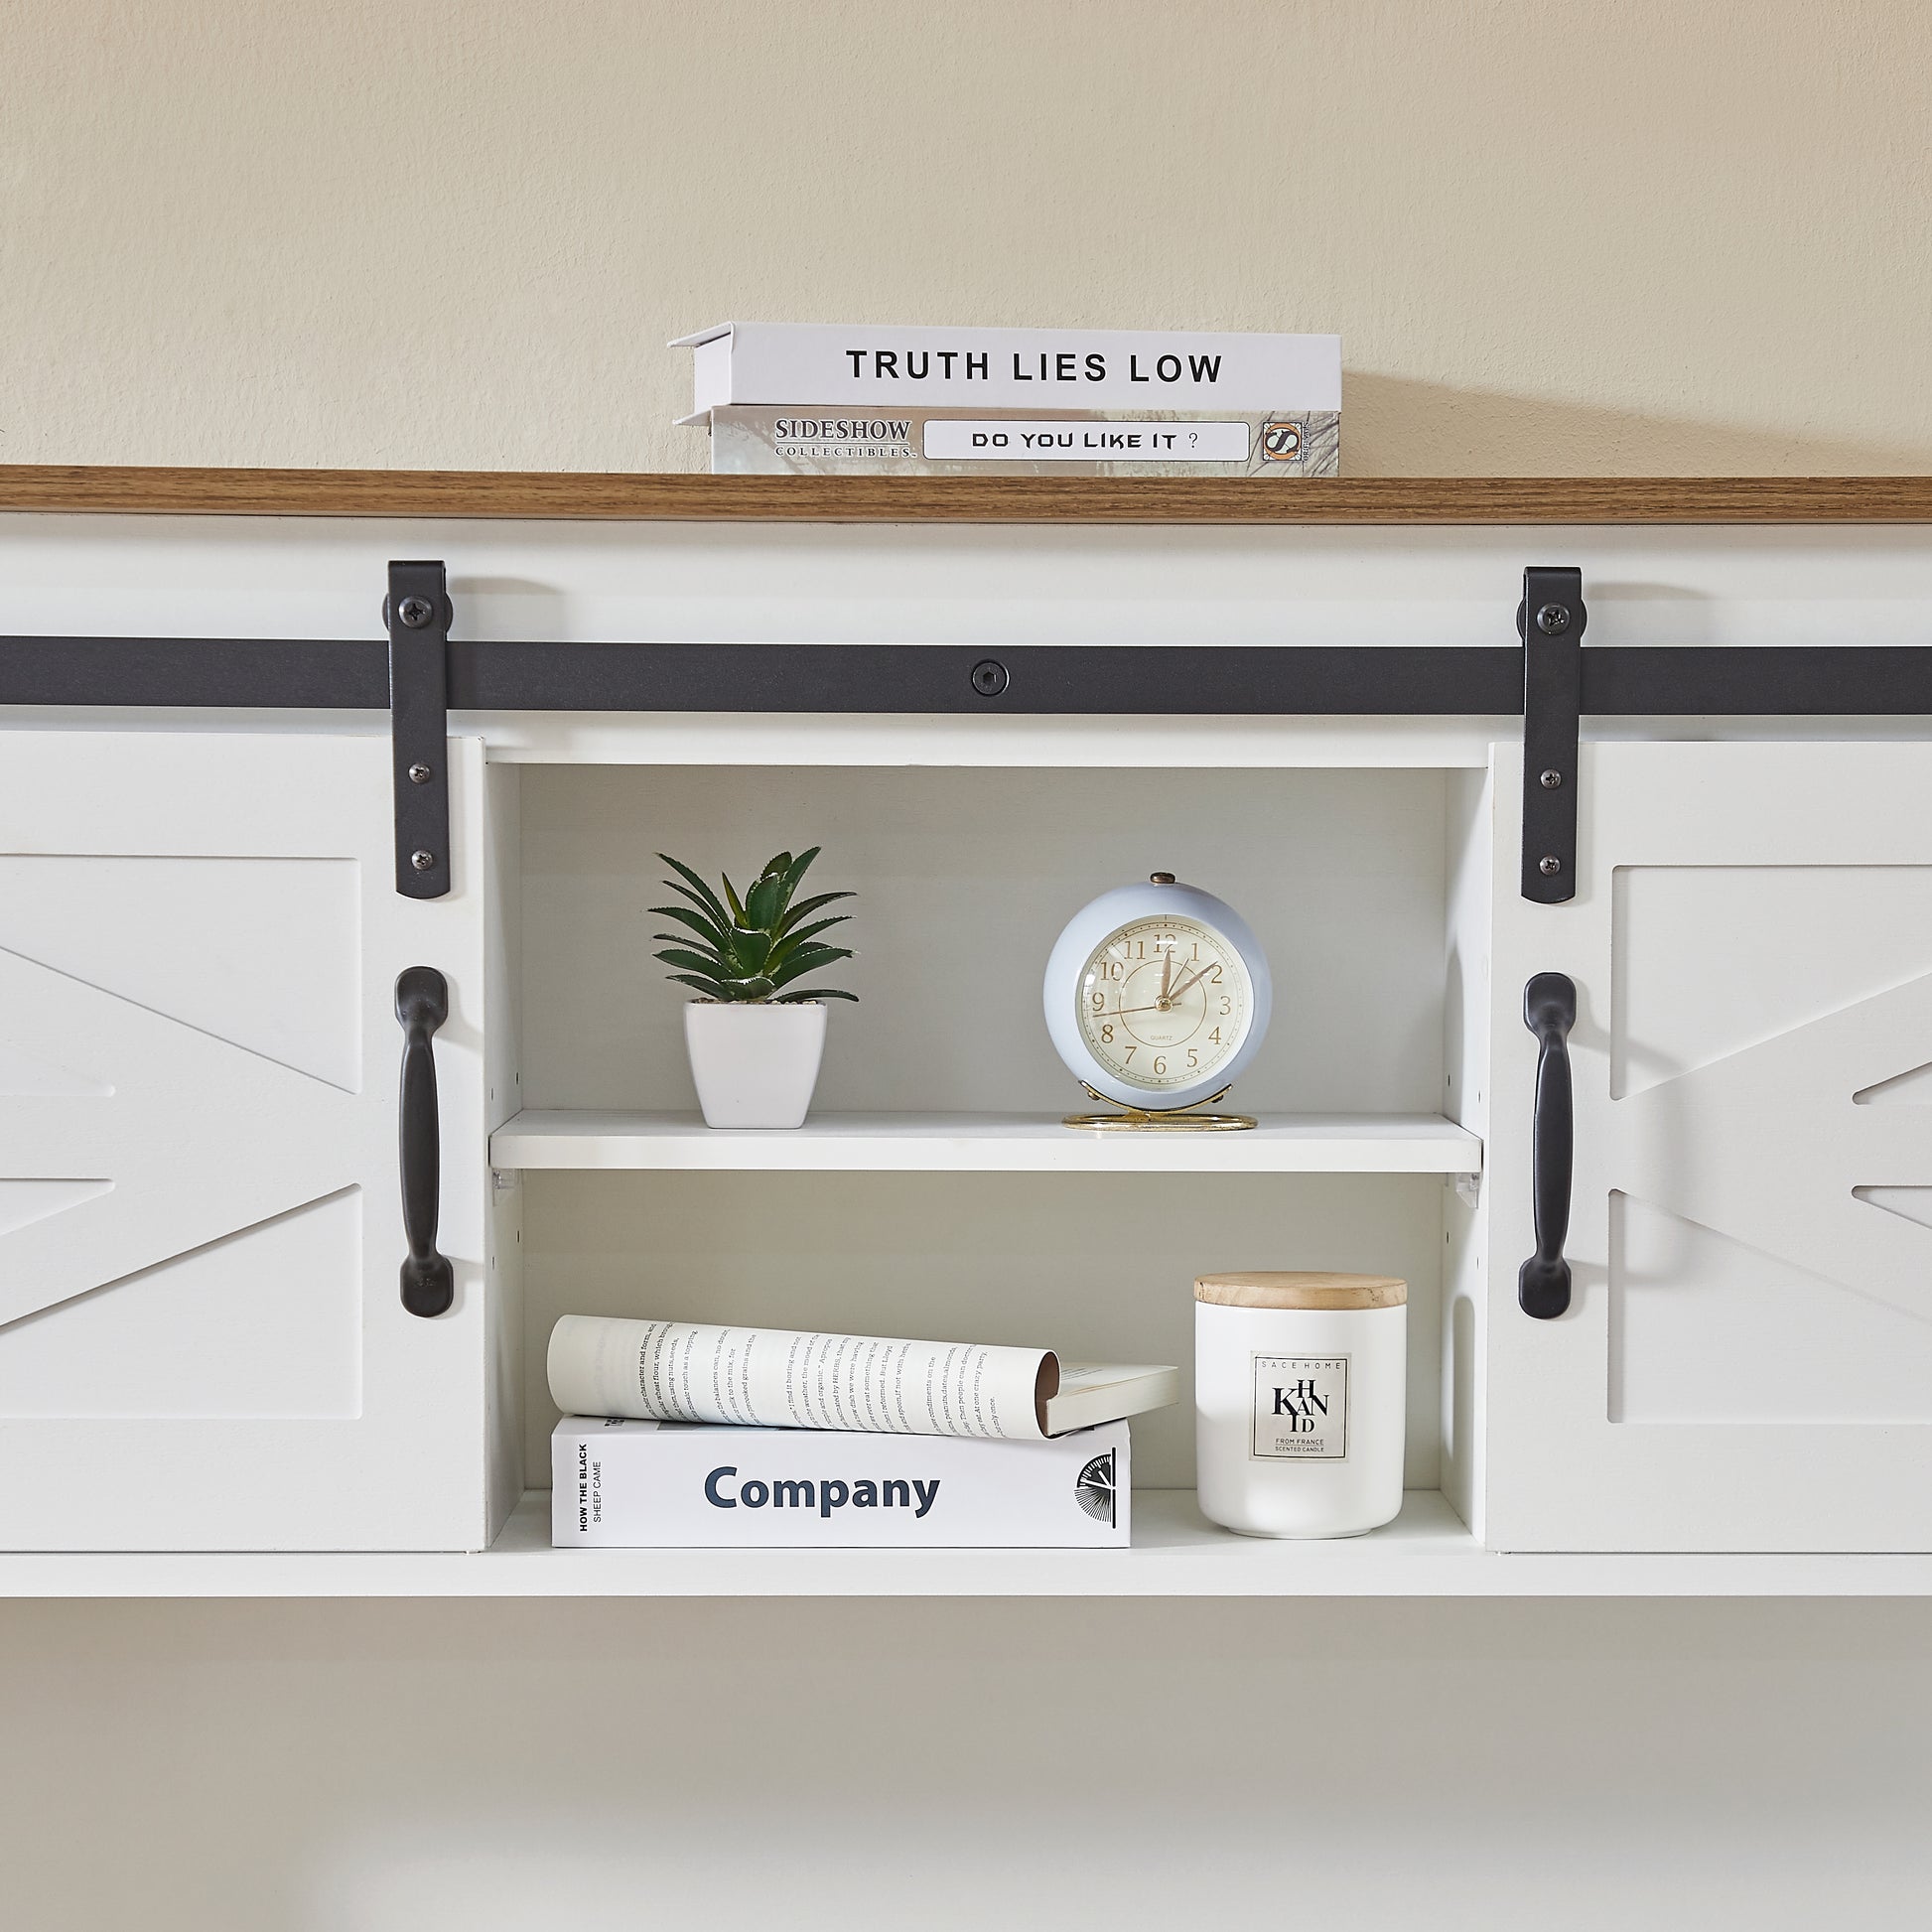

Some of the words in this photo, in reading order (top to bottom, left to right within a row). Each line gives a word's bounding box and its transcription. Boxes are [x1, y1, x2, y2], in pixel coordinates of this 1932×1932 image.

[845, 349, 990, 380] TRUTH
[1014, 352, 1107, 382] LIES
[1130, 354, 1223, 384] LOW
[775, 420, 910, 440] SIDESHOW
[971, 432, 1009, 448] DO
[1021, 433, 1076, 449] YOU
[1083, 433, 1145, 450] LIKE
[1152, 434, 1177, 450] IT
[1187, 432, 1199, 450] ?
[775, 447, 909, 457] COLLECTIBLES
[1124, 941, 1145, 959] 11
[1153, 934, 1175, 953] 12
[1191, 943, 1199, 961] 1
[1100, 961, 1124, 981] 10
[1211, 964, 1222, 983] 2
[1092, 993, 1104, 1011] 9
[1220, 996, 1231, 1015] 3
[1101, 1025, 1114, 1042] 8
[1208, 1027, 1221, 1044] 4
[1125, 1046, 1137, 1064] 7
[1187, 1049, 1198, 1067] 5
[1154, 1056, 1166, 1074] 6
[640, 1333, 651, 1349] form,
[748, 1334, 757, 1343] the
[653, 1339, 663, 1360] which
[716, 1345, 722, 1354] no
[803, 1347, 812, 1365] mood
[850, 1341, 865, 1361] having
[833, 1357, 842, 1383] HERBS,
[864, 1353, 876, 1390] something
[927, 1369, 933, 1378] on
[638, 1367, 647, 1397] character
[653, 1381, 662, 1400] wheat
[849, 1383, 854, 1393] we
[926, 1380, 935, 1418] condiments
[704, 1466, 941, 1518] Company
